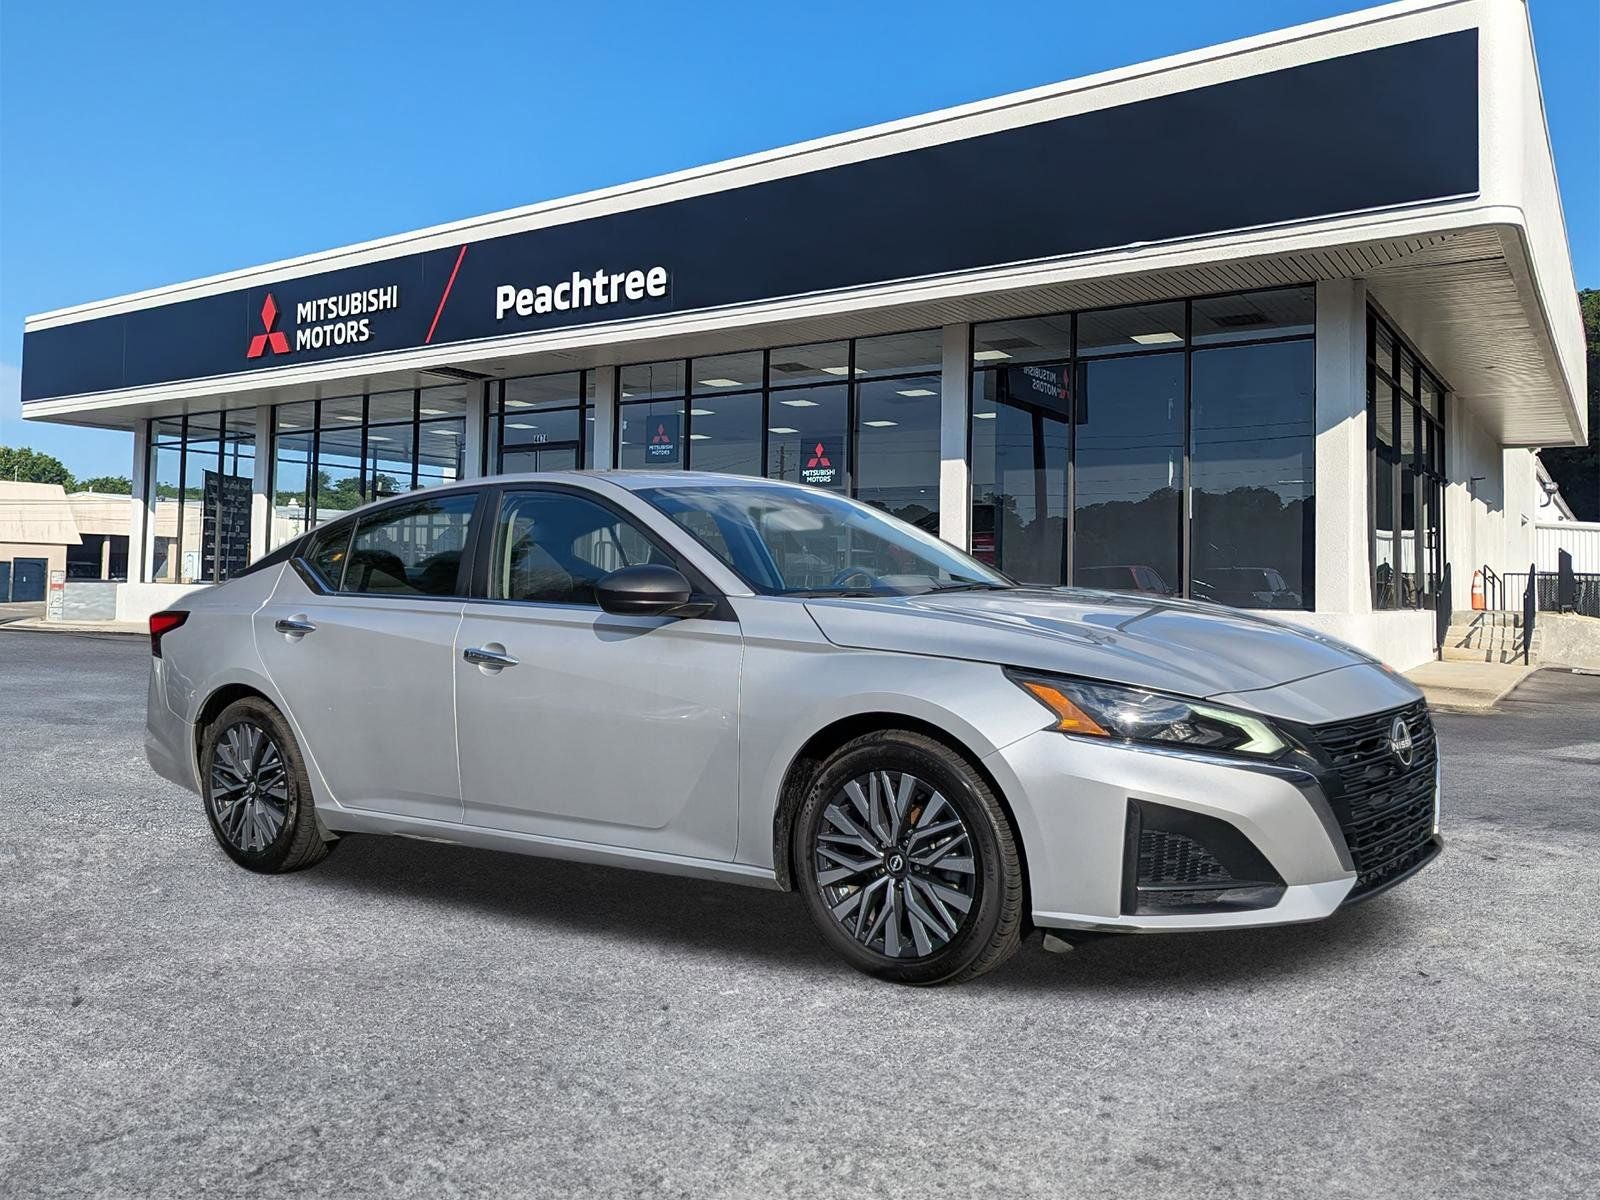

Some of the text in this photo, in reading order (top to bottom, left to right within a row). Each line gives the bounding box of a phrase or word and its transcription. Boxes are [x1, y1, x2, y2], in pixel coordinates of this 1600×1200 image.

[296, 285, 398, 324] MITSUBISHI
[496, 266, 667, 320] Peachtree
[296, 319, 370, 351] MOTORS
[1391, 739, 1412, 752] NISS
